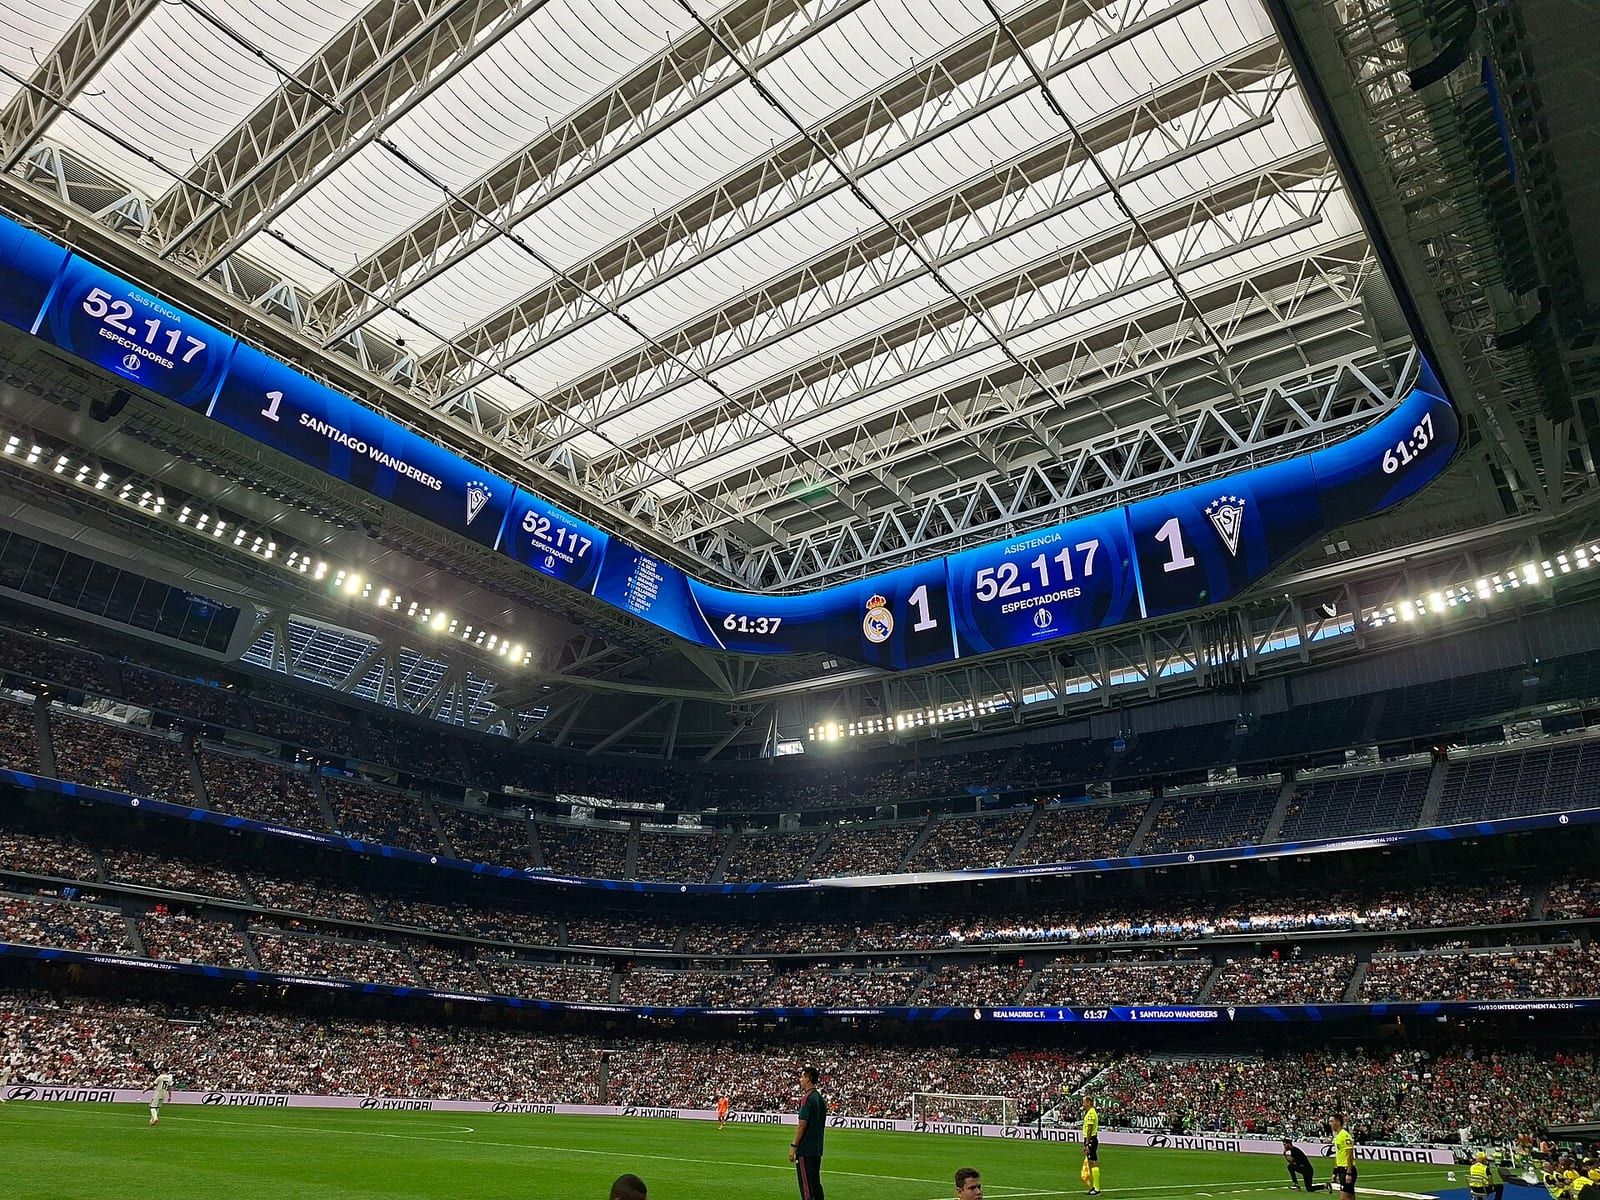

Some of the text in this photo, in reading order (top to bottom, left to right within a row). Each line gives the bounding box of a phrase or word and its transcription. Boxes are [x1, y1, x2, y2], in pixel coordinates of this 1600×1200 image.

[127, 291, 182, 324] ASISTENCIA
[82, 287, 207, 364] 52.117
[98, 328, 174, 369] ESPECTADORES
[261, 390, 443, 491] 1 SANTIAGO WANDERERS
[1382, 412, 1434, 474] 61:37
[546, 509, 578, 529] ASISTENCIA
[522, 510, 592, 558] 52.117
[1004, 532, 1062, 555] ASISTENCIA
[531, 539, 574, 564] ESPECTADORES
[1154, 516, 1195, 573] 1
[976, 539, 1099, 602] 52.117
[908, 584, 937, 633] 1
[1001, 587, 1081, 614] ESPECTADORES
[723, 613, 782, 634] 61:37
[993, 1010, 1009, 1018] REAL
[1008, 1010, 1033, 1018] MADRID
[1058, 1010, 1064, 1019] 1
[1083, 1010, 1108, 1020] 61:37
[1130, 1010, 1137, 1020] 1
[1139, 1011, 1175, 1019] SANTIAGO
[1175, 1011, 1218, 1019] WANDERERS
[41, 1089, 116, 1102] HYUNDAI
[229, 1094, 289, 1107] HYUNDAI
[382, 1099, 433, 1111] HYUNDAI
[511, 1103, 556, 1114] HYUNDAI
[640, 1107, 680, 1119] HYUNDAI
[740, 1113, 782, 1124] HYUNDAI
[850, 1118, 897, 1131] HYUNDAI
[933, 1123, 983, 1136] HYUNDAI
[1024, 1127, 1080, 1143] HYUNDAI
[1174, 1138, 1242, 1153] HYUNDAI
[1354, 1147, 1434, 1164] HYUNDAI
